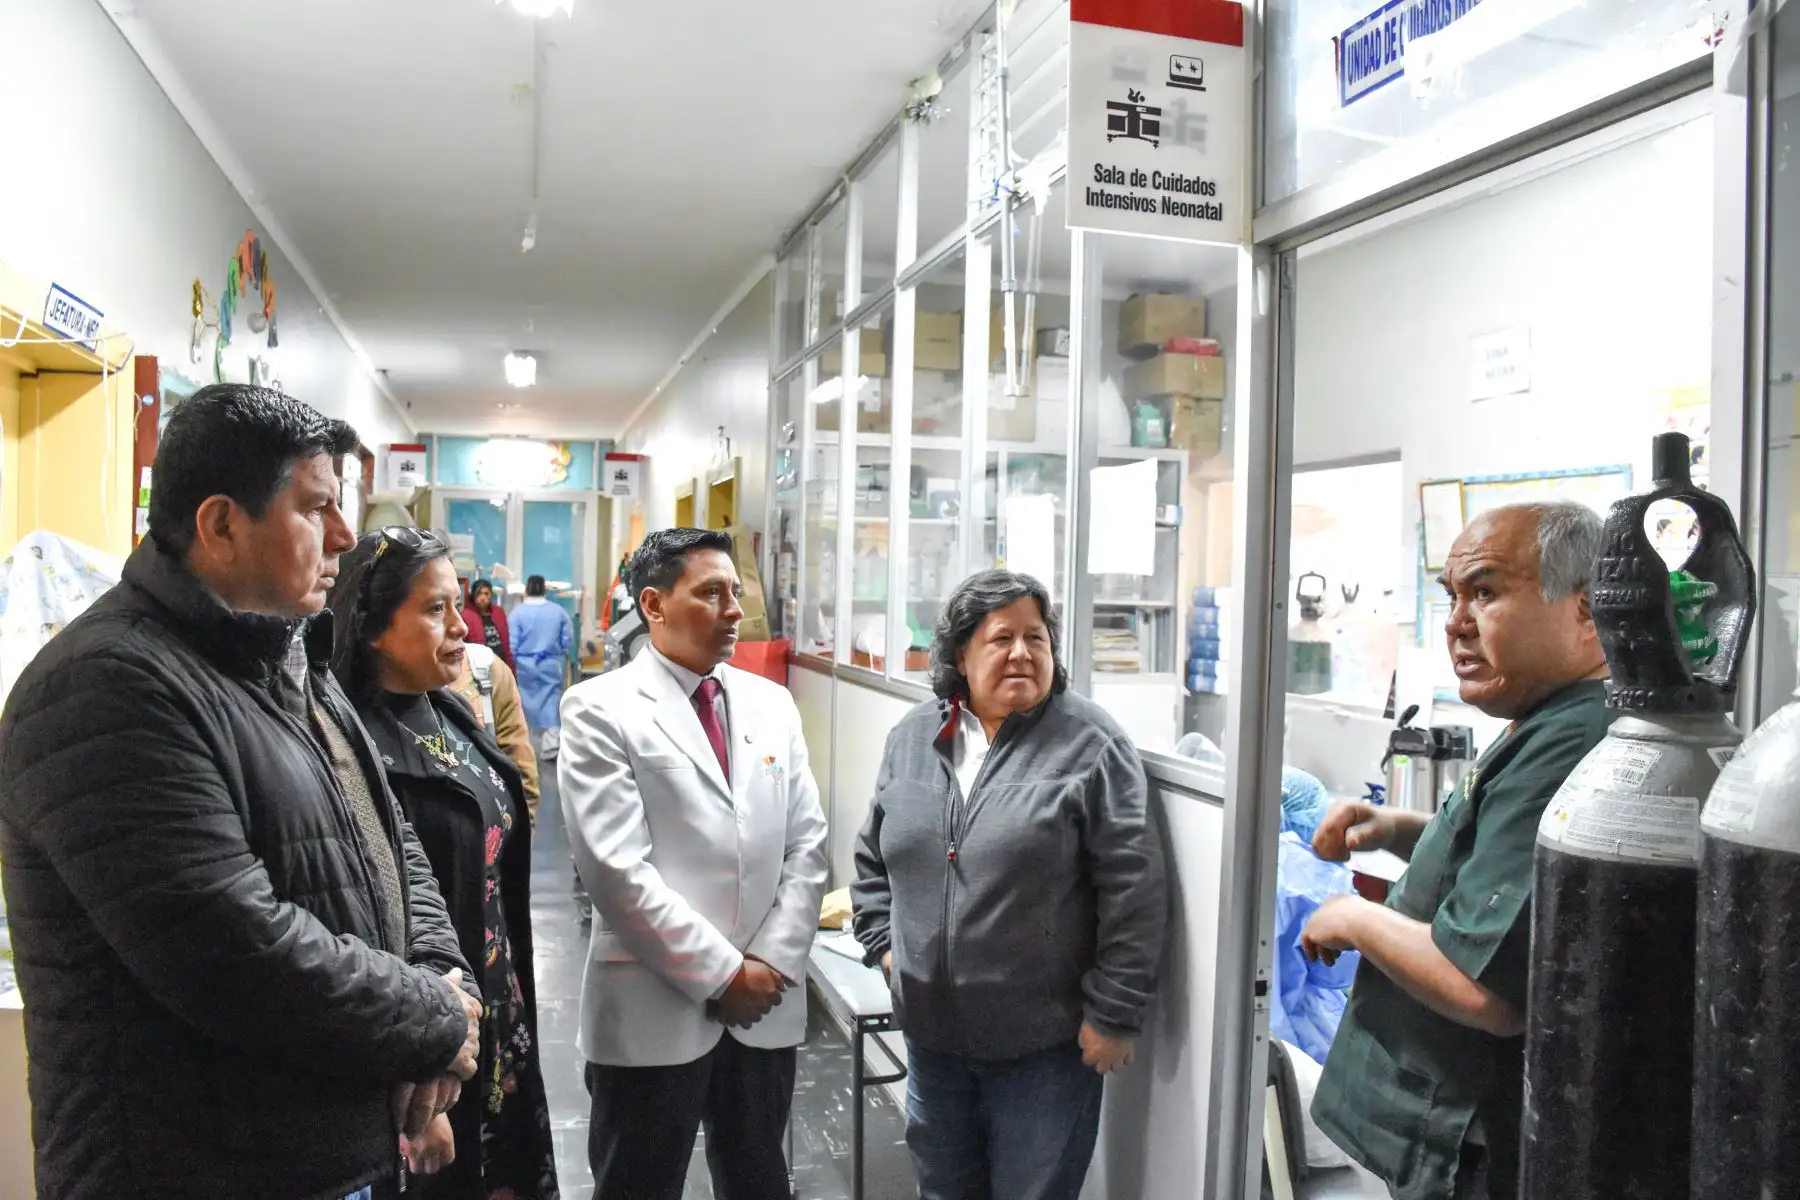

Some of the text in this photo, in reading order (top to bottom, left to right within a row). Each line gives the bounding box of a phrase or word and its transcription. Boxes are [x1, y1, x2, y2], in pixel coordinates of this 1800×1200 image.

[1347, 27, 1382, 86] UNIDAD
[1384, 16, 1397, 66] DE
[1094, 163, 1216, 197] Sala de Cuidados
[1086, 186, 1223, 221] Intensivos Neonatal
